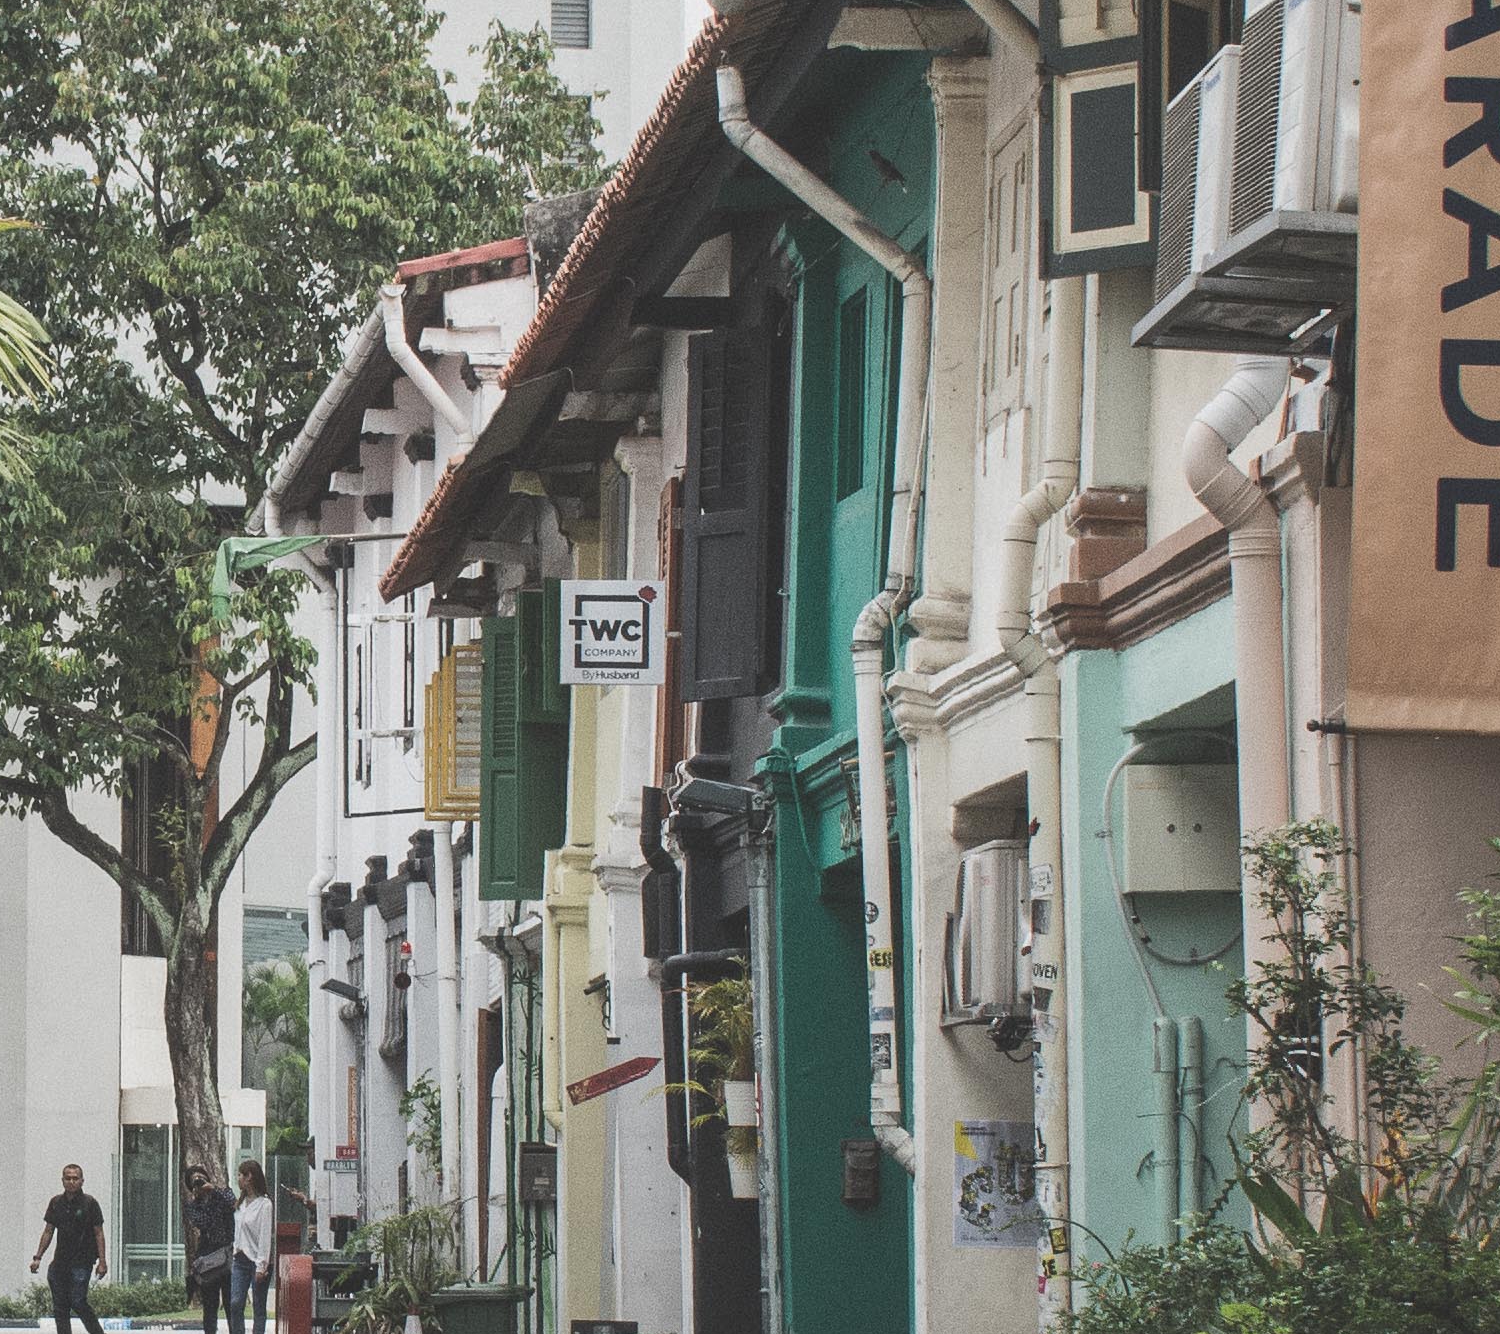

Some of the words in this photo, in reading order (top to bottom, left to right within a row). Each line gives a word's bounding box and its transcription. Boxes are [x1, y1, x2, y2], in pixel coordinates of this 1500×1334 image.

[569, 619, 641, 641] TWC
[584, 648, 637, 657] COMPANY
[581, 670, 595, 681] By
[595, 670, 640, 680] Husband
